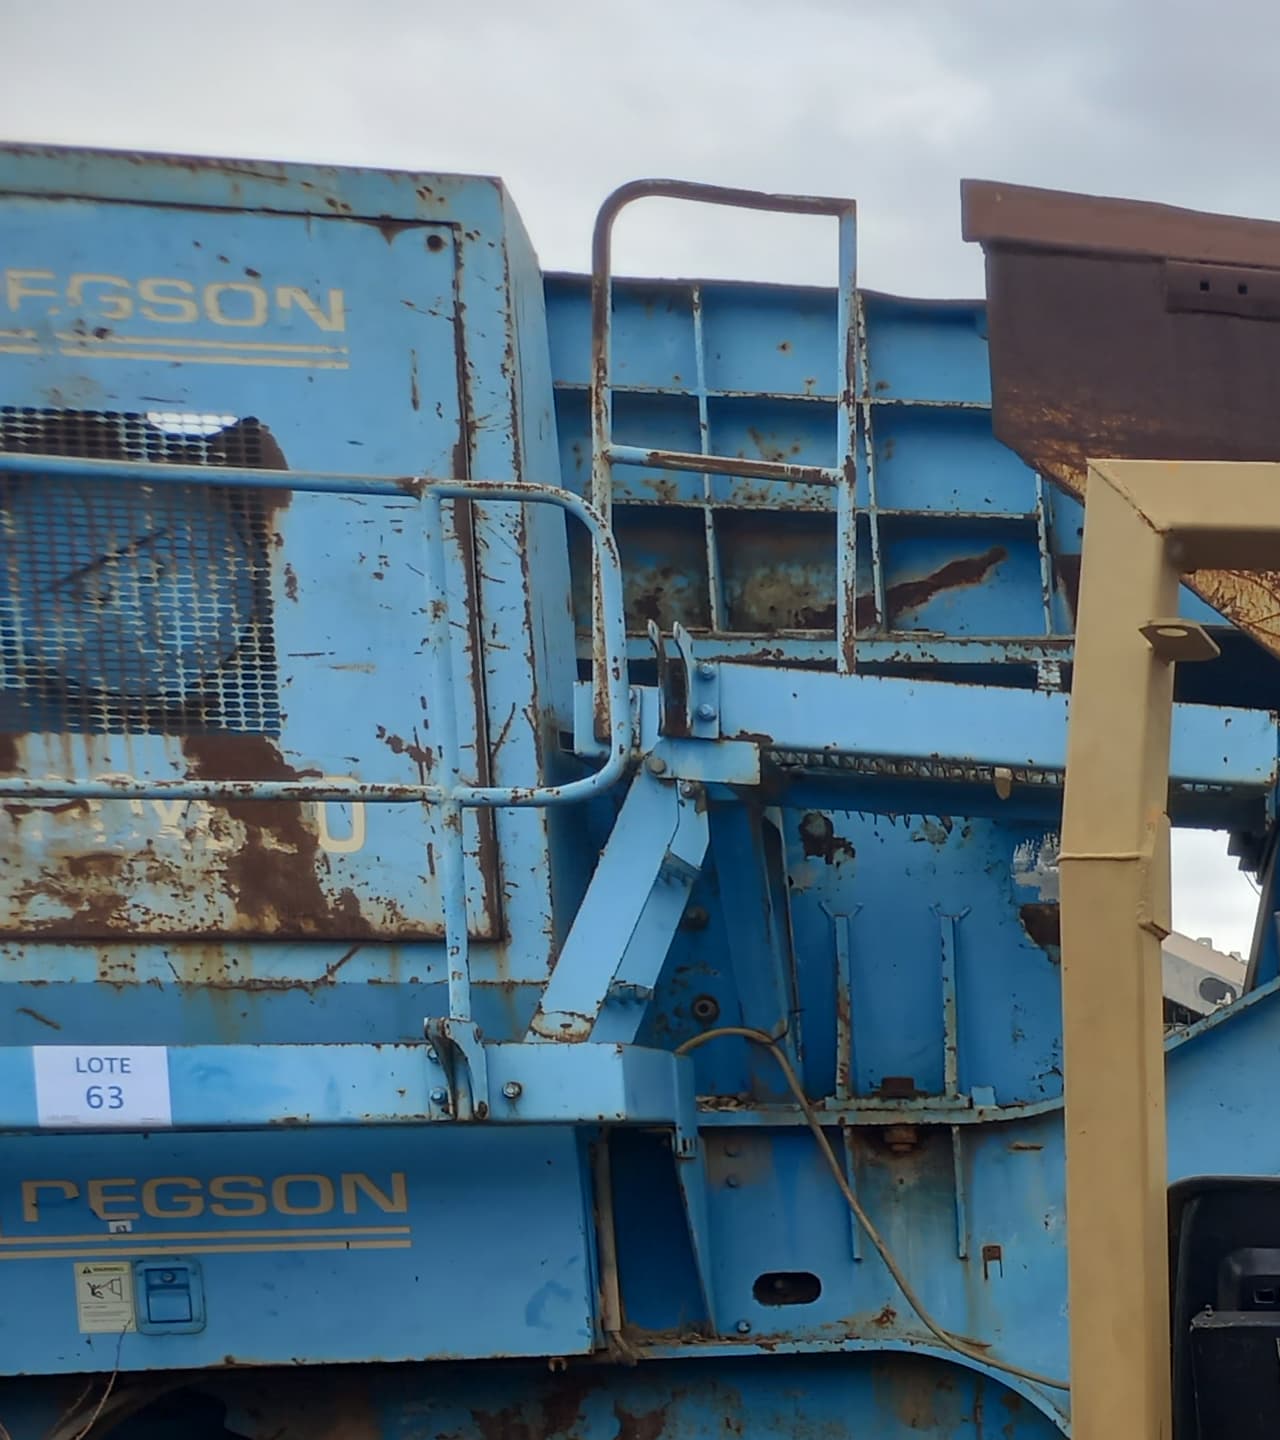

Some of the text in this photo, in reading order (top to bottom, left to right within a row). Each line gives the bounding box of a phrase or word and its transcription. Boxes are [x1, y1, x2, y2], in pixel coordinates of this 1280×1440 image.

[76, 1057, 131, 1074] LOTE
[85, 1086, 124, 1109] 63
[21, 1172, 408, 1222] PEGSON
